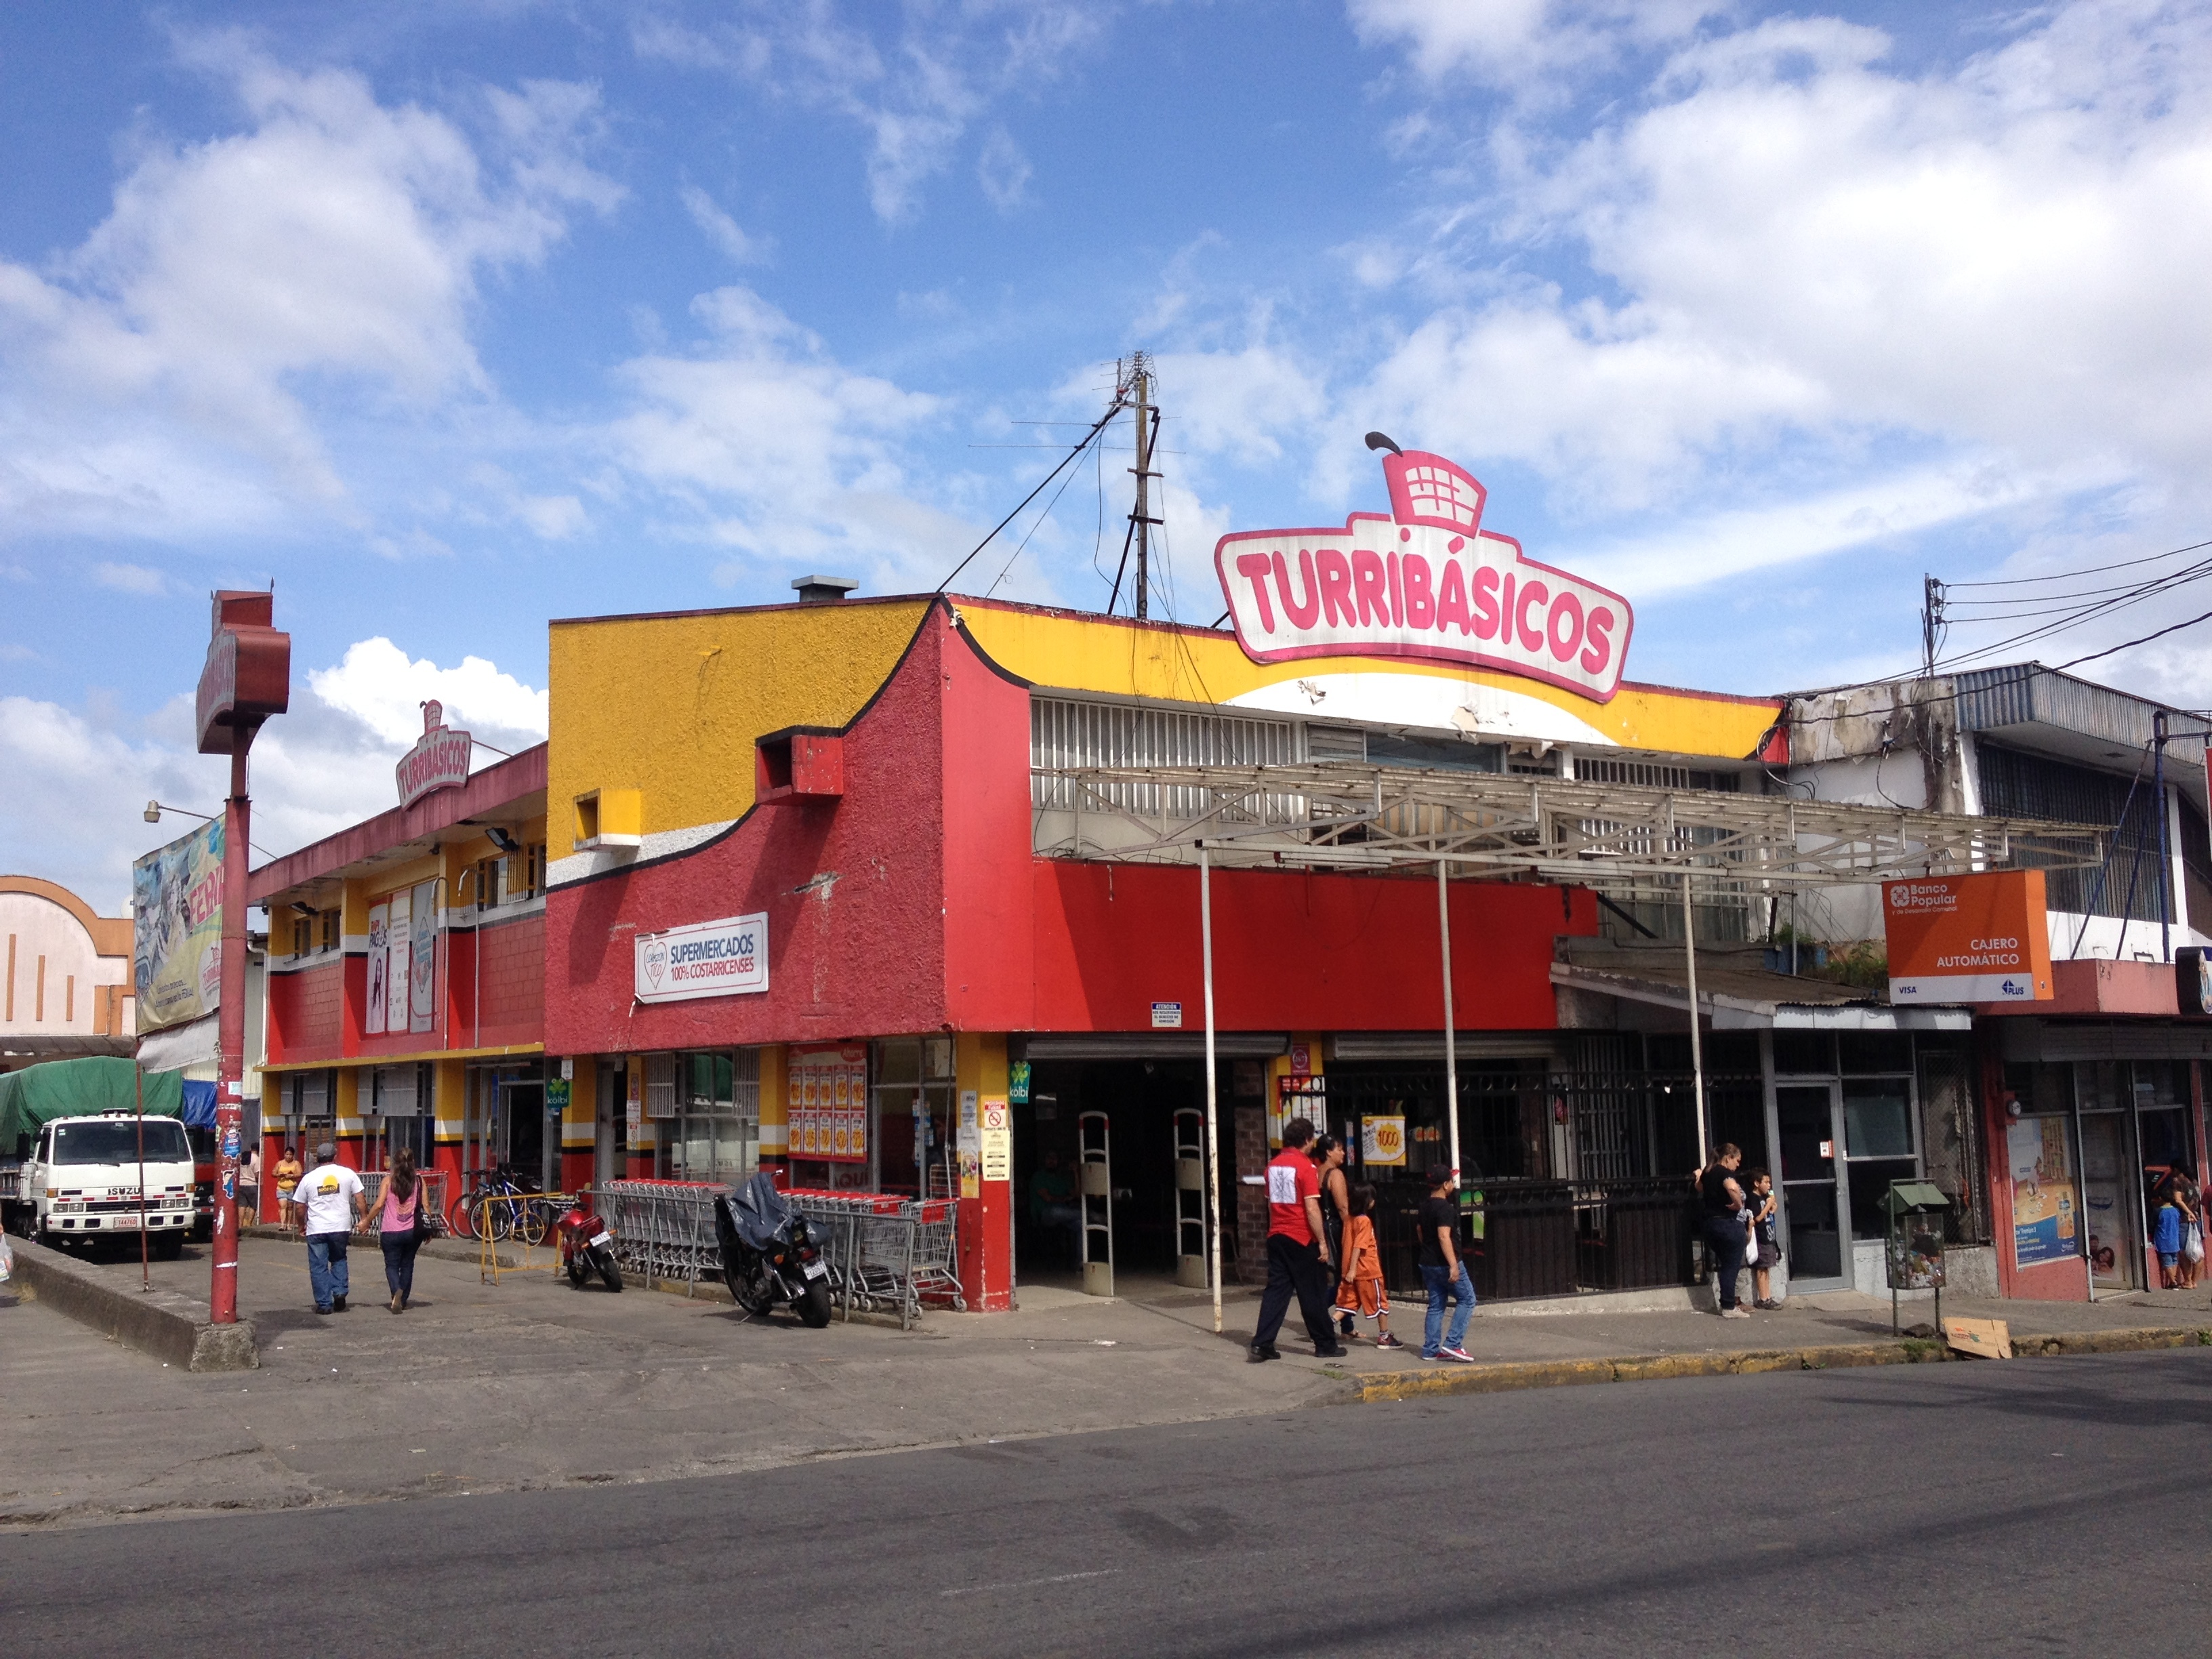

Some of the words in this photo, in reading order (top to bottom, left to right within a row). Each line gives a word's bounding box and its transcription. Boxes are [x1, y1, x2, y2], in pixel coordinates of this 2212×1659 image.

[1237, 527, 1615, 675] TURRIBÁSICOS
[398, 733, 467, 800] TURRIBÁSICOS
[1910, 884, 1947, 895] Banco
[1911, 895, 1957, 907] Popular
[671, 933, 754, 964] SUPERMERCADOS
[1971, 937, 2018, 950] CAJERO
[1937, 952, 2020, 968] AUTOMÁTICO
[650, 963, 662, 977] TICO
[671, 965, 690, 981] 100%
[690, 956, 754, 979] COSTARRICENSES
[1898, 986, 1917, 994] VISA
[2008, 986, 2024, 996] PLUS
[1009, 1086, 1029, 1097] kölbi
[1378, 1130, 1399, 1147] 1000
[108, 1187, 141, 1195] ISUZU
